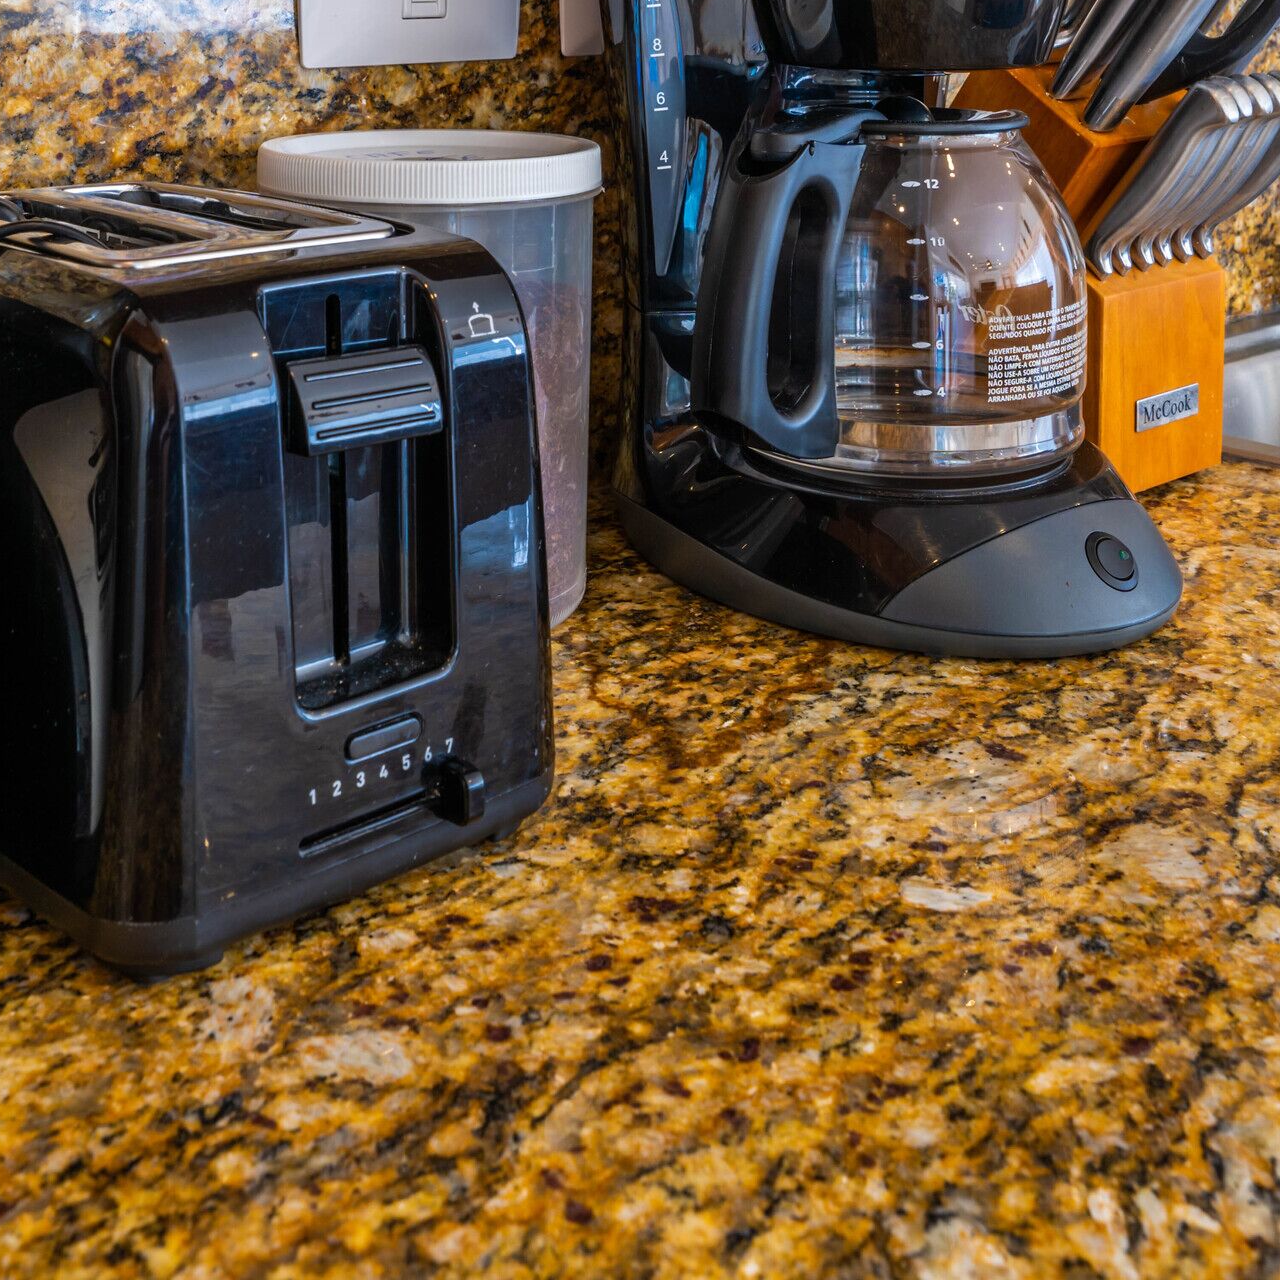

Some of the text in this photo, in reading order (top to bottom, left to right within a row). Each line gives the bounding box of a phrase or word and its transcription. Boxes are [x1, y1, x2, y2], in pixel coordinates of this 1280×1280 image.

[653, 38, 662, 51] 8
[656, 92, 665, 105] 6
[659, 150, 669, 163] 4
[924, 179, 940, 189] 12
[930, 237, 945, 247] 10
[1016, 322, 1042, 330] COLOQUE
[989, 331, 1022, 340] SEGUNDOS
[1023, 328, 1046, 337] QUANDO
[936, 339, 944, 350] 6
[1032, 343, 1045, 351] PARA
[988, 354, 1003, 363] NÃO
[1022, 351, 1038, 360] FERVA
[1039, 347, 1060, 358] LÍQUIDOS
[988, 362, 1003, 371] NÃO
[1004, 361, 1027, 370] LIMPE-A
[988, 370, 1003, 379] NÃO
[1004, 369, 1022, 378] USE-A
[1023, 367, 1040, 376] SOBRE
[1040, 365, 1049, 373] UM
[988, 378, 1003, 387] NÃO
[1004, 376, 1032, 386] SEGURE-A
[1034, 373, 1045, 381] COM
[988, 386, 1009, 395] JOGUE
[1010, 384, 1025, 393] FORA
[1027, 383, 1033, 391] SE
[1034, 382, 1038, 390] A
[1039, 378, 1056, 389] MESMA
[937, 387, 946, 397] 4
[988, 393, 1026, 403] ARRANHADA
[1027, 391, 1036, 399] OU
[1037, 389, 1043, 397] SE
[1043, 388, 1051, 396] FOI
[1144, 394, 1191, 424] McCook
[309, 737, 454, 805] 1 2 3 4 5 6 7
